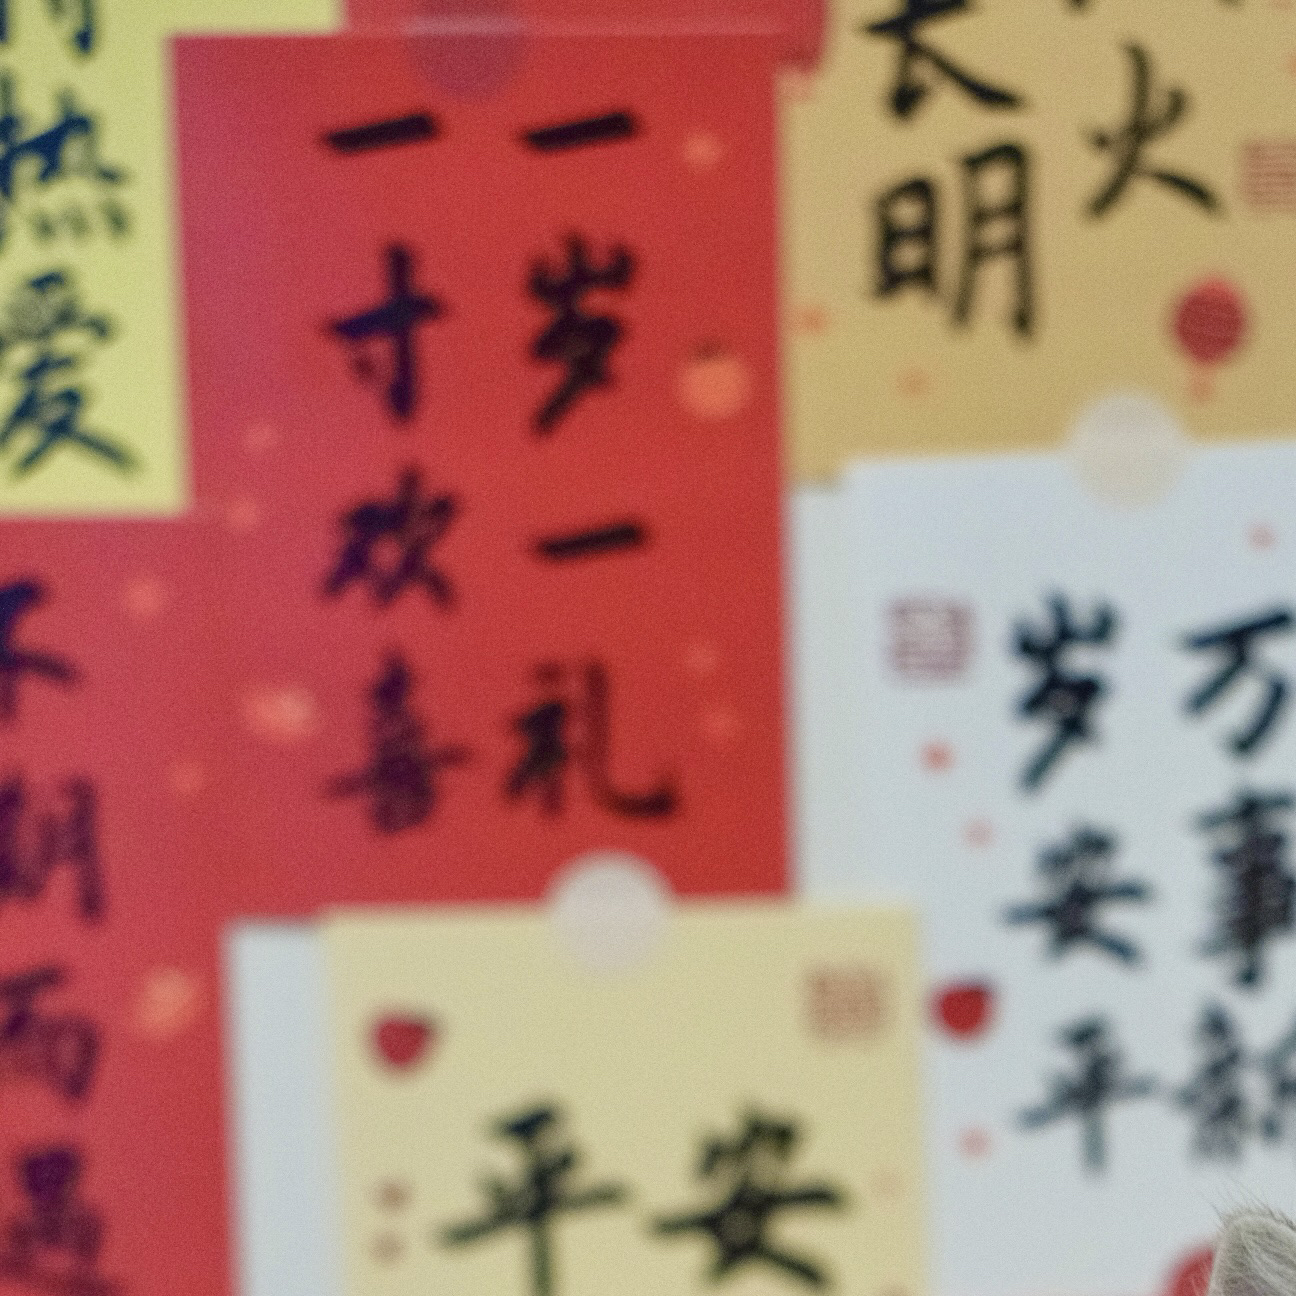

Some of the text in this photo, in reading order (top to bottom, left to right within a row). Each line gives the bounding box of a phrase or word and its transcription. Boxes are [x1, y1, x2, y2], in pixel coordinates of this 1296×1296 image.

[0, 0, 140, 478] 热爱
[1068, 0, 1232, 222] 火
[324, 110, 470, 834] 一寸欢喜
[505, 110, 682, 818] 一岁一礼
